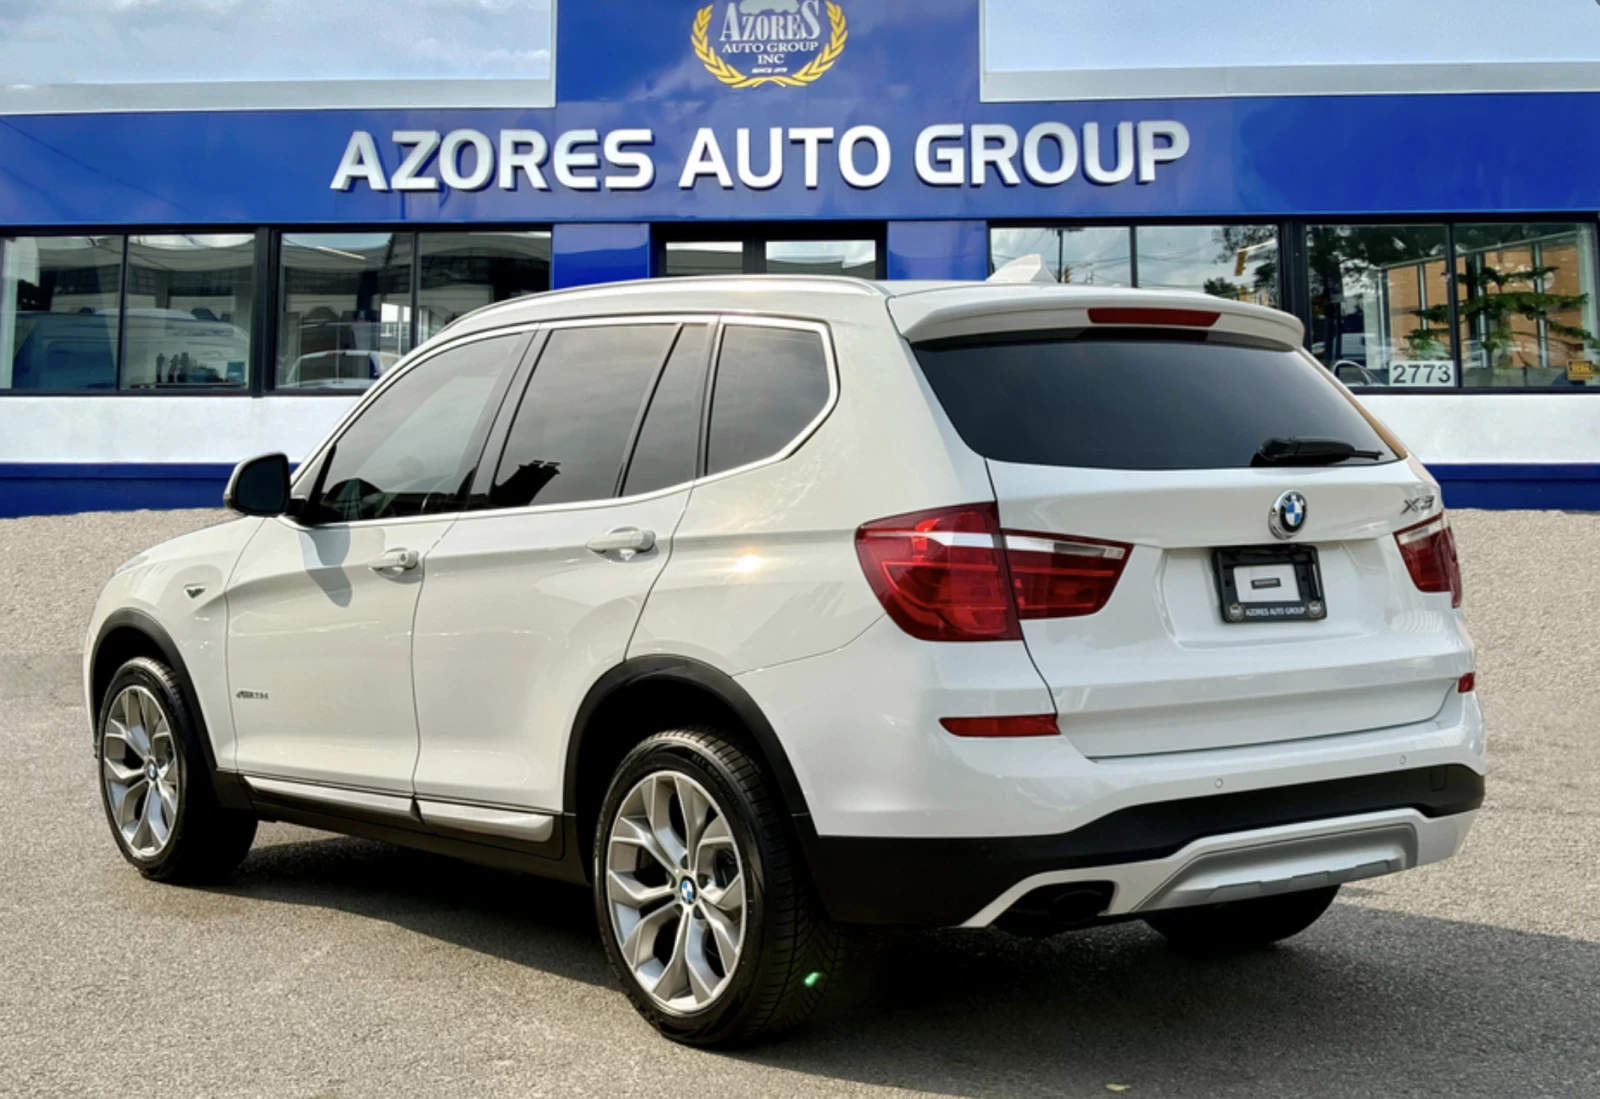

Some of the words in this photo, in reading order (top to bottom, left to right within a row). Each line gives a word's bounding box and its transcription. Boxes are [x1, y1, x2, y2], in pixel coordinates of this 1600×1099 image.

[719, 0, 821, 41] AZORES
[722, 43, 764, 53] AUTO
[766, 41, 819, 53] GROUP
[757, 53, 785, 65] INC
[329, 128, 655, 191] AZORES
[678, 125, 892, 189] AUTO
[914, 120, 1191, 186] GROUP
[1392, 363, 1451, 385] 2773
[1400, 494, 1435, 515] X3
[1245, 607, 1269, 617] AZORES
[1269, 607, 1285, 616] AUTO
[1285, 606, 1306, 615] GROUP
